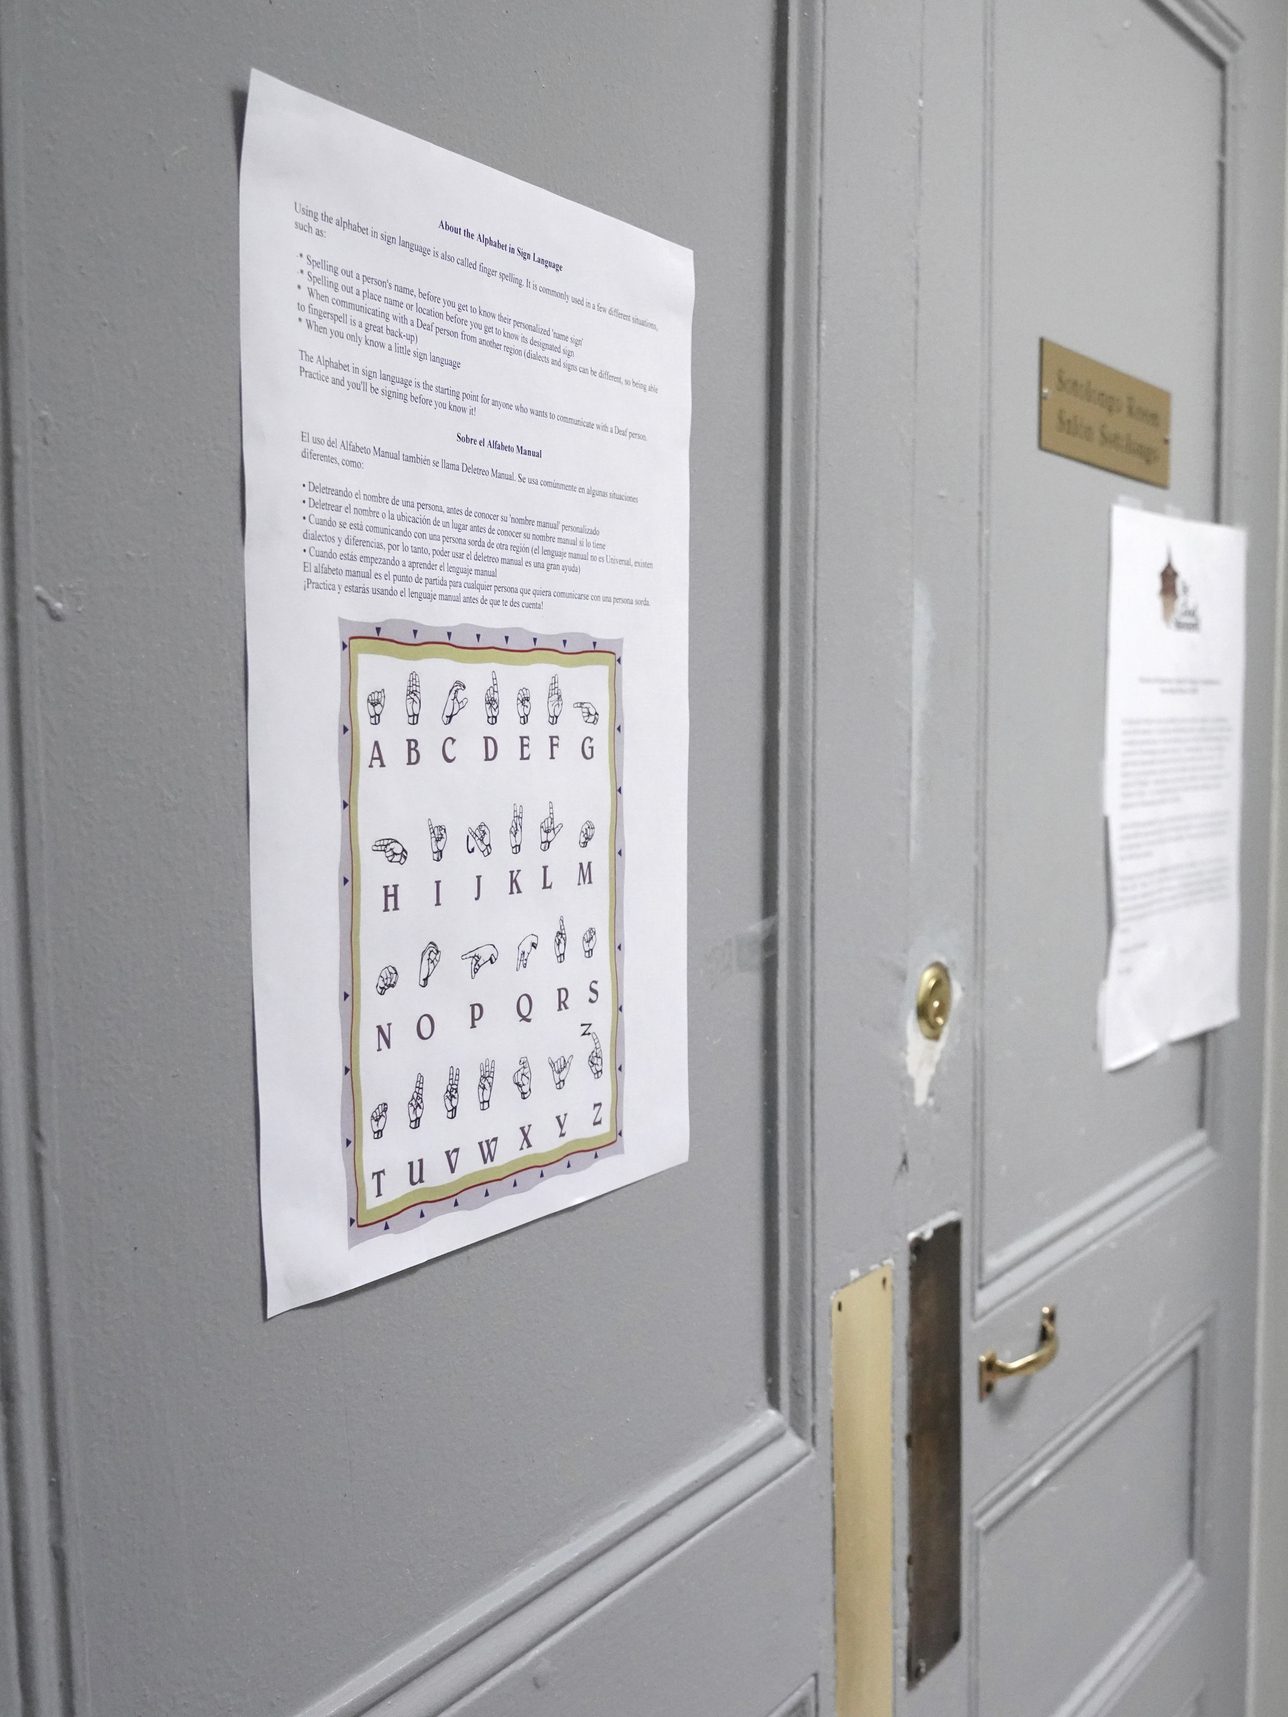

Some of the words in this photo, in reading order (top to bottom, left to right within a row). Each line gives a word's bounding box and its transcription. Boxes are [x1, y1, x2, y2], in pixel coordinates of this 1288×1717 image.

[295, 222, 313, 234] such
[315, 228, 326, 238] as:
[439, 220, 462, 236] About
[463, 229, 475, 240] the
[477, 233, 508, 252] Alphabet
[508, 244, 516, 254] in
[517, 247, 531, 261] Sign
[533, 252, 563, 272] Language
[306, 255, 339, 277] Spelling
[341, 268, 354, 278] out
[394, 284, 416, 298] name,
[418, 288, 441, 304] before
[443, 299, 456, 308] you
[457, 303, 469, 312] get
[470, 305, 478, 314] to
[478, 306, 496, 320] know
[498, 313, 512, 324] their
[513, 319, 551, 336] personalized
[307, 272, 339, 293] Spelling
[341, 285, 354, 294] out
[362, 289, 382, 302] place
[384, 297, 404, 308] name
[406, 303, 414, 311] or
[415, 303, 444, 320] location
[445, 311, 468, 327] before
[470, 321, 483, 331] you
[484, 325, 494, 335] get
[495, 327, 502, 336] to
[502, 328, 519, 341] know
[521, 333, 529, 344] its
[529, 336, 562, 353] designated
[562, 346, 575, 359] sign
[297, 302, 306, 313] to
[308, 304, 348, 325] fingerspell
[350, 316, 357, 327] is
[358, 321, 363, 329] a
[365, 323, 384, 334] great
[385, 326, 419, 346] back-up)
[306, 320, 328, 335] When
[330, 329, 345, 340] you
[346, 333, 362, 347] only
[364, 335, 386, 350] know
[388, 344, 393, 352] a
[394, 343, 411, 356] little
[413, 349, 428, 362] sign
[429, 352, 461, 371] language
[299, 367, 330, 383] Practice
[331, 376, 345, 387] and
[370, 383, 379, 395] be
[381, 387, 409, 404] signing
[410, 393, 433, 406] before
[434, 401, 447, 411] you
[448, 401, 467, 414] know
[469, 406, 477, 416] it!
[301, 448, 340, 467] diferentes,
[341, 459, 364, 469] como:
[456, 433, 478, 446] Sobre
[479, 439, 486, 447] el
[487, 440, 515, 453] Alfabeto
[516, 445, 543, 459] Manual
[308, 482, 353, 499] Deletreando
[355, 490, 362, 500] el
[363, 493, 390, 504] nombre
[391, 495, 400, 506] de
[402, 500, 415, 508] una
[416, 503, 445, 515] persona,
[446, 507, 463, 516] antes
[464, 507, 473, 517] de
[474, 512, 499, 521] conocer
[561, 525, 600, 536] personalizado
[308, 498, 343, 512] Deletrear
[344, 504, 352, 514] el
[353, 507, 380, 518] nombre
[388, 510, 395, 520] la
[396, 512, 432, 526] ubicación
[432, 517, 441, 527] de
[451, 520, 468, 533] lugar
[470, 525, 487, 533] antes
[487, 525, 496, 535] de
[497, 529, 522, 538] conocer
[532, 533, 556, 543] nombre
[557, 538, 578, 546] manual
[579, 539, 585, 547] si
[586, 539, 592, 548] lo
[592, 540, 606, 550] tiene
[309, 546, 338, 560] Cuando
[339, 551, 358, 562] estás
[359, 556, 401, 567] empezando
[408, 561, 438, 571] aprender
[439, 563, 446, 572] el
[446, 563, 473, 577] lenguaje
[474, 569, 498, 578] manual
[304, 579, 336, 591] ¡Practica
[338, 585, 343, 595] y
[344, 584, 370, 594] estarás
[372, 587, 399, 597] usando
[400, 588, 407, 598] el
[408, 589, 437, 603] lenguaje
[438, 594, 462, 603] manual
[463, 596, 479, 604] antes
[480, 596, 488, 605] de
[489, 599, 501, 608] que
[502, 599, 508, 607] te
[509, 599, 521, 608] des
[521, 602, 544, 610] cuenta!
[367, 740, 387, 769] A
[405, 738, 421, 766] B
[441, 736, 457, 764] C
[482, 735, 499, 762] D
[518, 735, 531, 761] E
[548, 735, 560, 760] F
[580, 735, 595, 761] G
[382, 883, 400, 913] H
[434, 879, 442, 907] I
[474, 874, 483, 902] J
[508, 869, 523, 896] K
[541, 865, 553, 890] L
[577, 861, 593, 886] M
[375, 1022, 393, 1052] N
[416, 1013, 435, 1041] O
[469, 1002, 484, 1030] P
[516, 993, 533, 1023] Q
[556, 987, 569, 1012] R
[588, 979, 599, 1004] S
[371, 1168, 386, 1198] T
[407, 1158, 425, 1187] U
[444, 1147, 461, 1175] V
[477, 1136, 499, 1165] W
[518, 1123, 533, 1151] X
[555, 1112, 568, 1139] Y
[592, 1101, 603, 1127] Z
